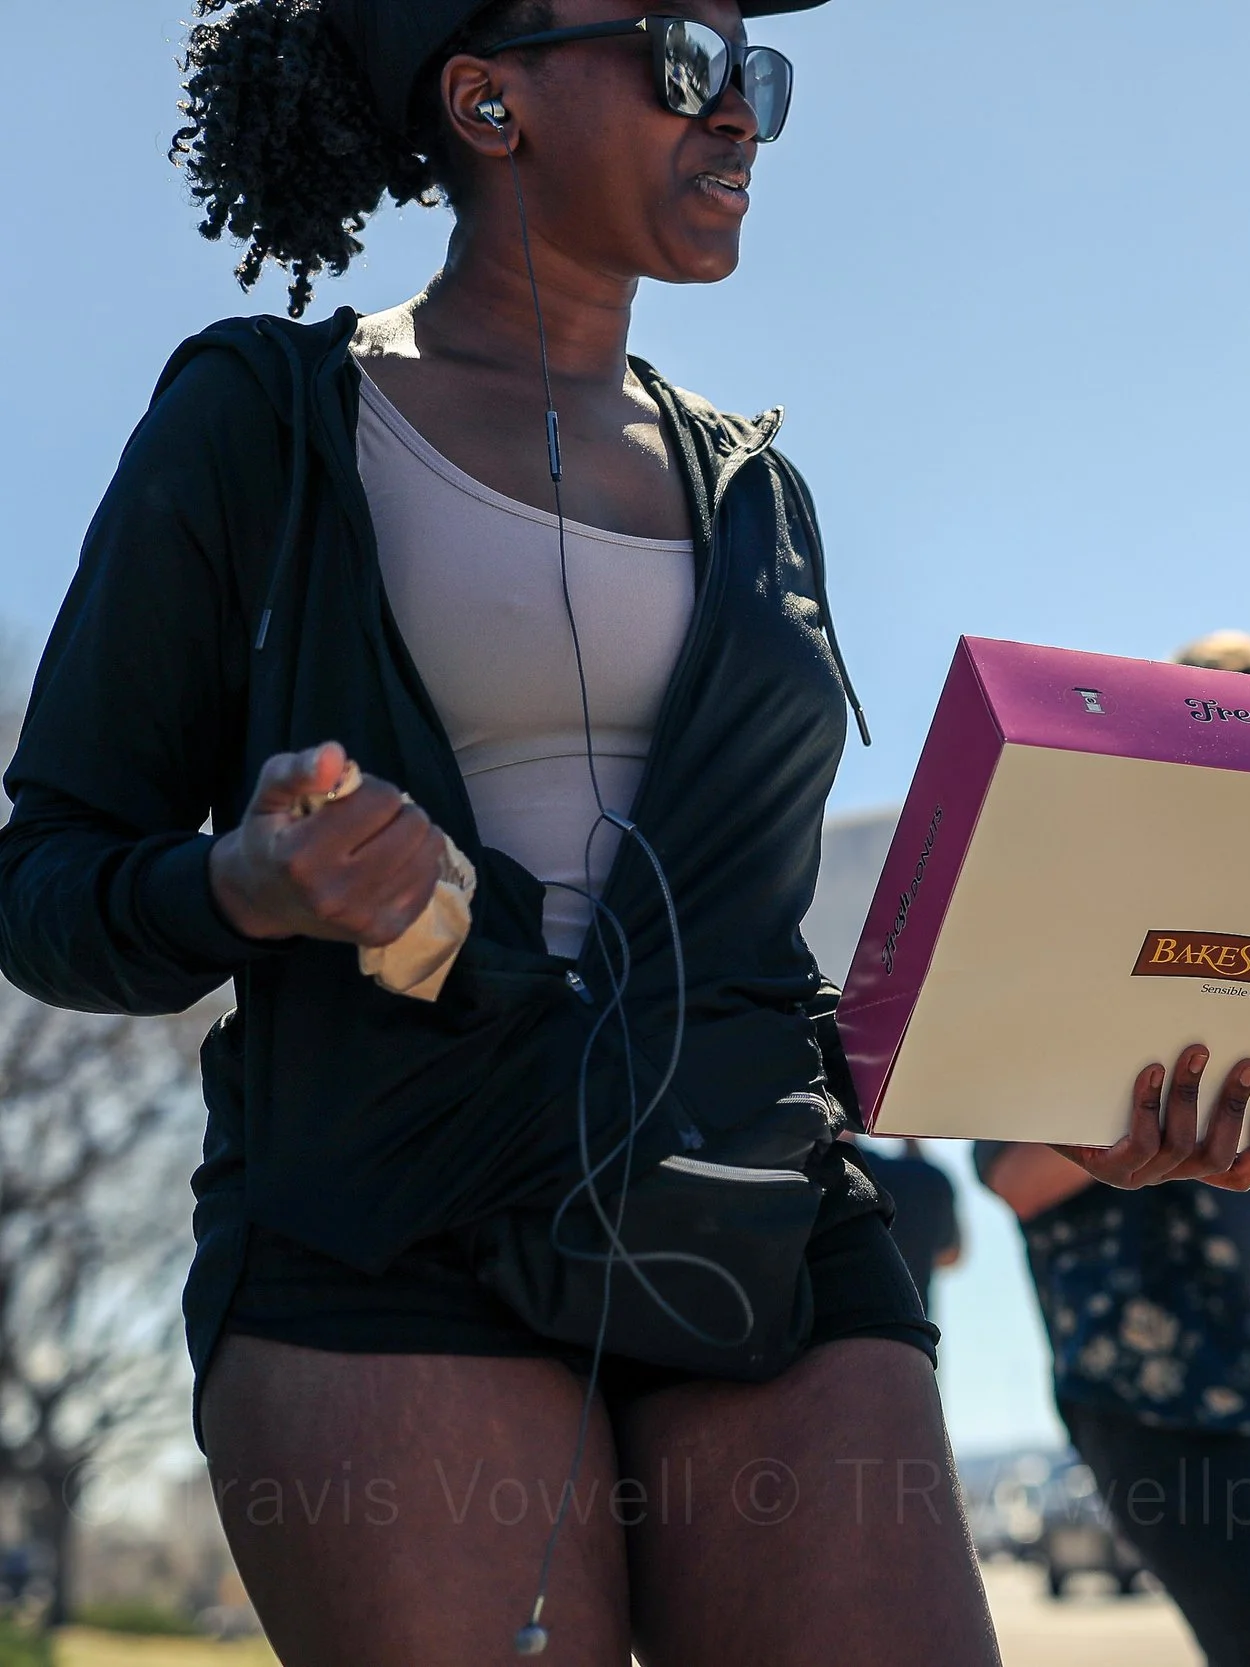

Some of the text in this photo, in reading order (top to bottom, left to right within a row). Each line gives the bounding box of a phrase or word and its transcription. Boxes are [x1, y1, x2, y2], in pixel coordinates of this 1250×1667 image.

[881, 804, 943, 976] Fresh DONUTS
[1200, 983, 1248, 997] Sensible
